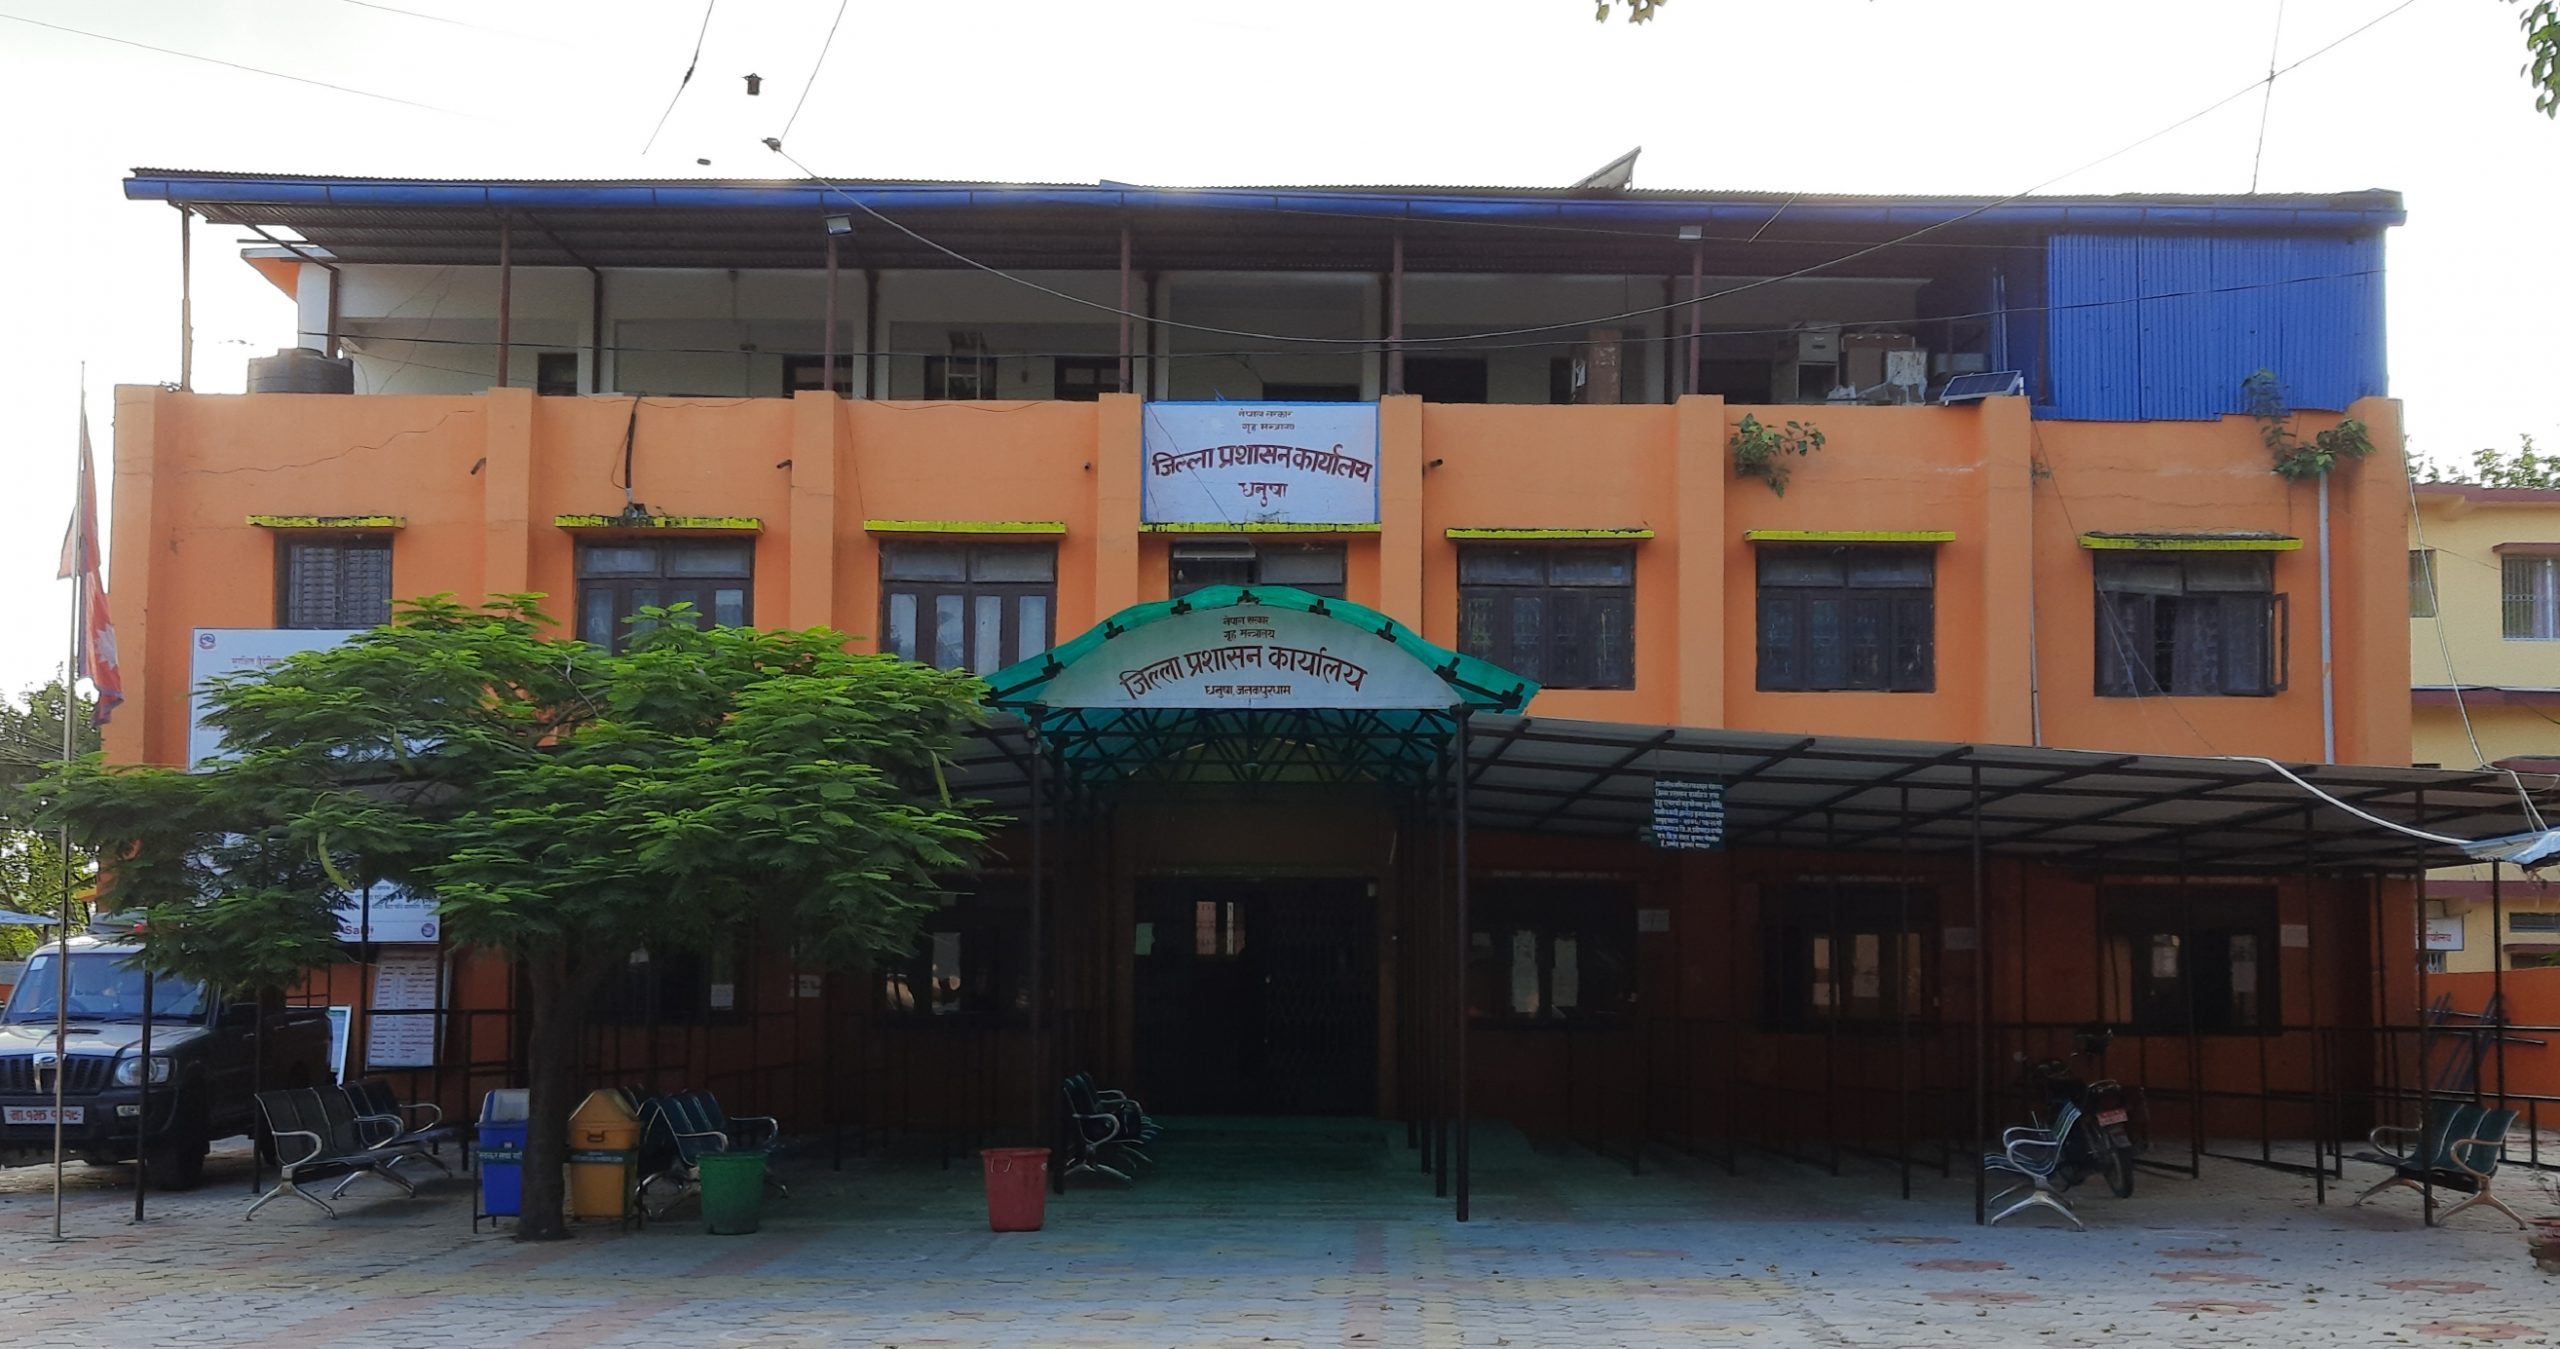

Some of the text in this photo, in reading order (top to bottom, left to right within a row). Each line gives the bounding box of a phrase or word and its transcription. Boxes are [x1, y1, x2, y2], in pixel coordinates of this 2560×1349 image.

[1152, 443, 1374, 483] जिल्ला प्रशासन कार्यालय
[1238, 482, 1289, 508] धनुषा
[1119, 644, 1370, 700] जिल्ला प्रशासन कार्यालय
